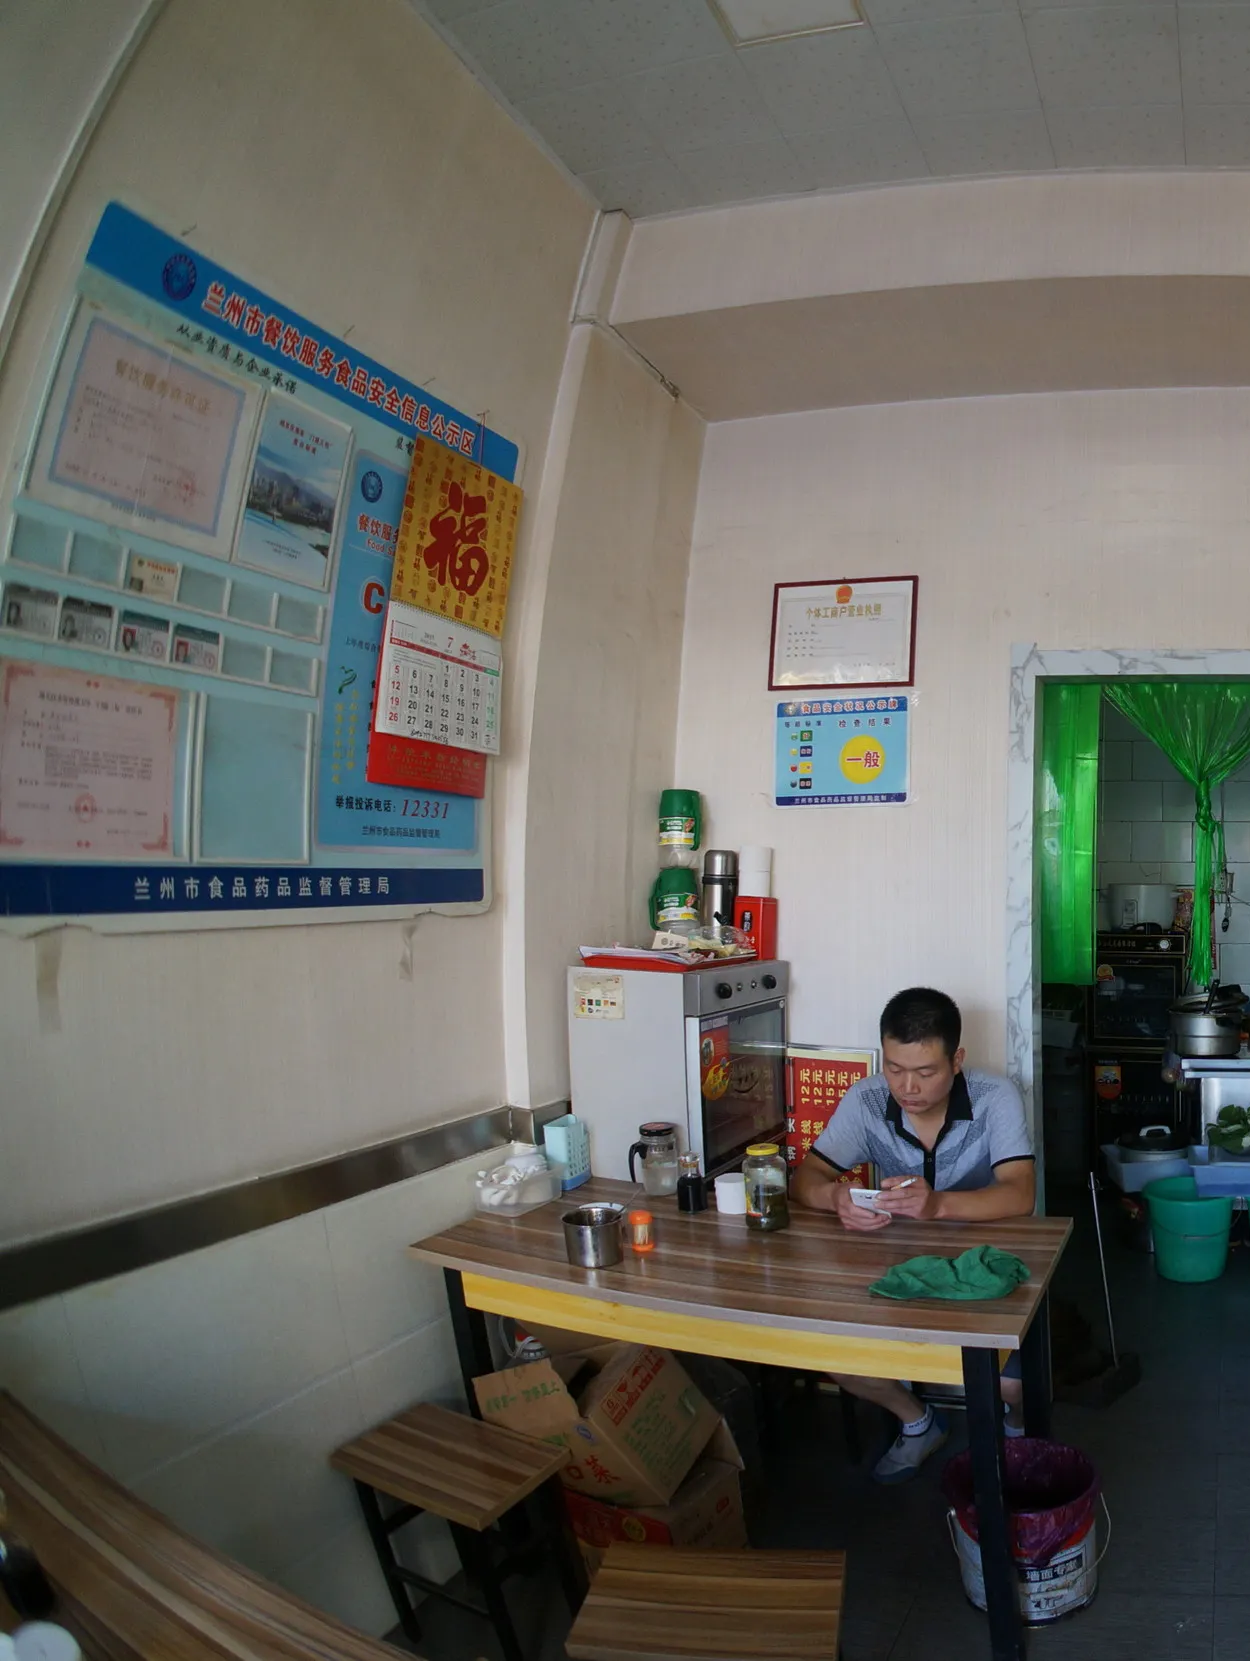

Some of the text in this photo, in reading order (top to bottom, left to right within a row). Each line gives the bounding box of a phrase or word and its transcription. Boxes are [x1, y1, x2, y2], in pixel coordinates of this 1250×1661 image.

[201, 280, 475, 456] 兰州市餐饮服务食品安全信息公示区
[423, 481, 490, 597] 福
[363, 582, 385, 614] C
[806, 603, 882, 620] 个体工商户营业执照
[392, 681, 400, 690] 12
[410, 686, 417, 694] 13
[426, 689, 434, 698] 14
[442, 694, 449, 702] 15
[458, 699, 465, 707] 16
[413, 670, 417, 678] 6
[473, 688, 479, 696] 10
[389, 712, 398, 721] 26
[407, 716, 416, 724] 27
[425, 720, 432, 728] 28
[440, 724, 448, 732] 29
[456, 728, 464, 736] 30
[390, 697, 399, 705] 19
[408, 701, 417, 709] 20
[425, 705, 433, 713] 21
[441, 709, 448, 717] 22
[457, 713, 464, 721] 23
[471, 717, 478, 725] 24
[839, 717, 891, 728] 检查结果
[846, 751, 880, 768] 一般
[400, 799, 449, 819] 12331
[362, 825, 440, 838] 兰州市食品药品监督管理局
[134, 875, 391, 900] 兰州市食品药品监督管理局
[800, 1068, 811, 1104] 12元
[813, 1069, 823, 1106] 12元
[825, 1070, 835, 1106] 15元
